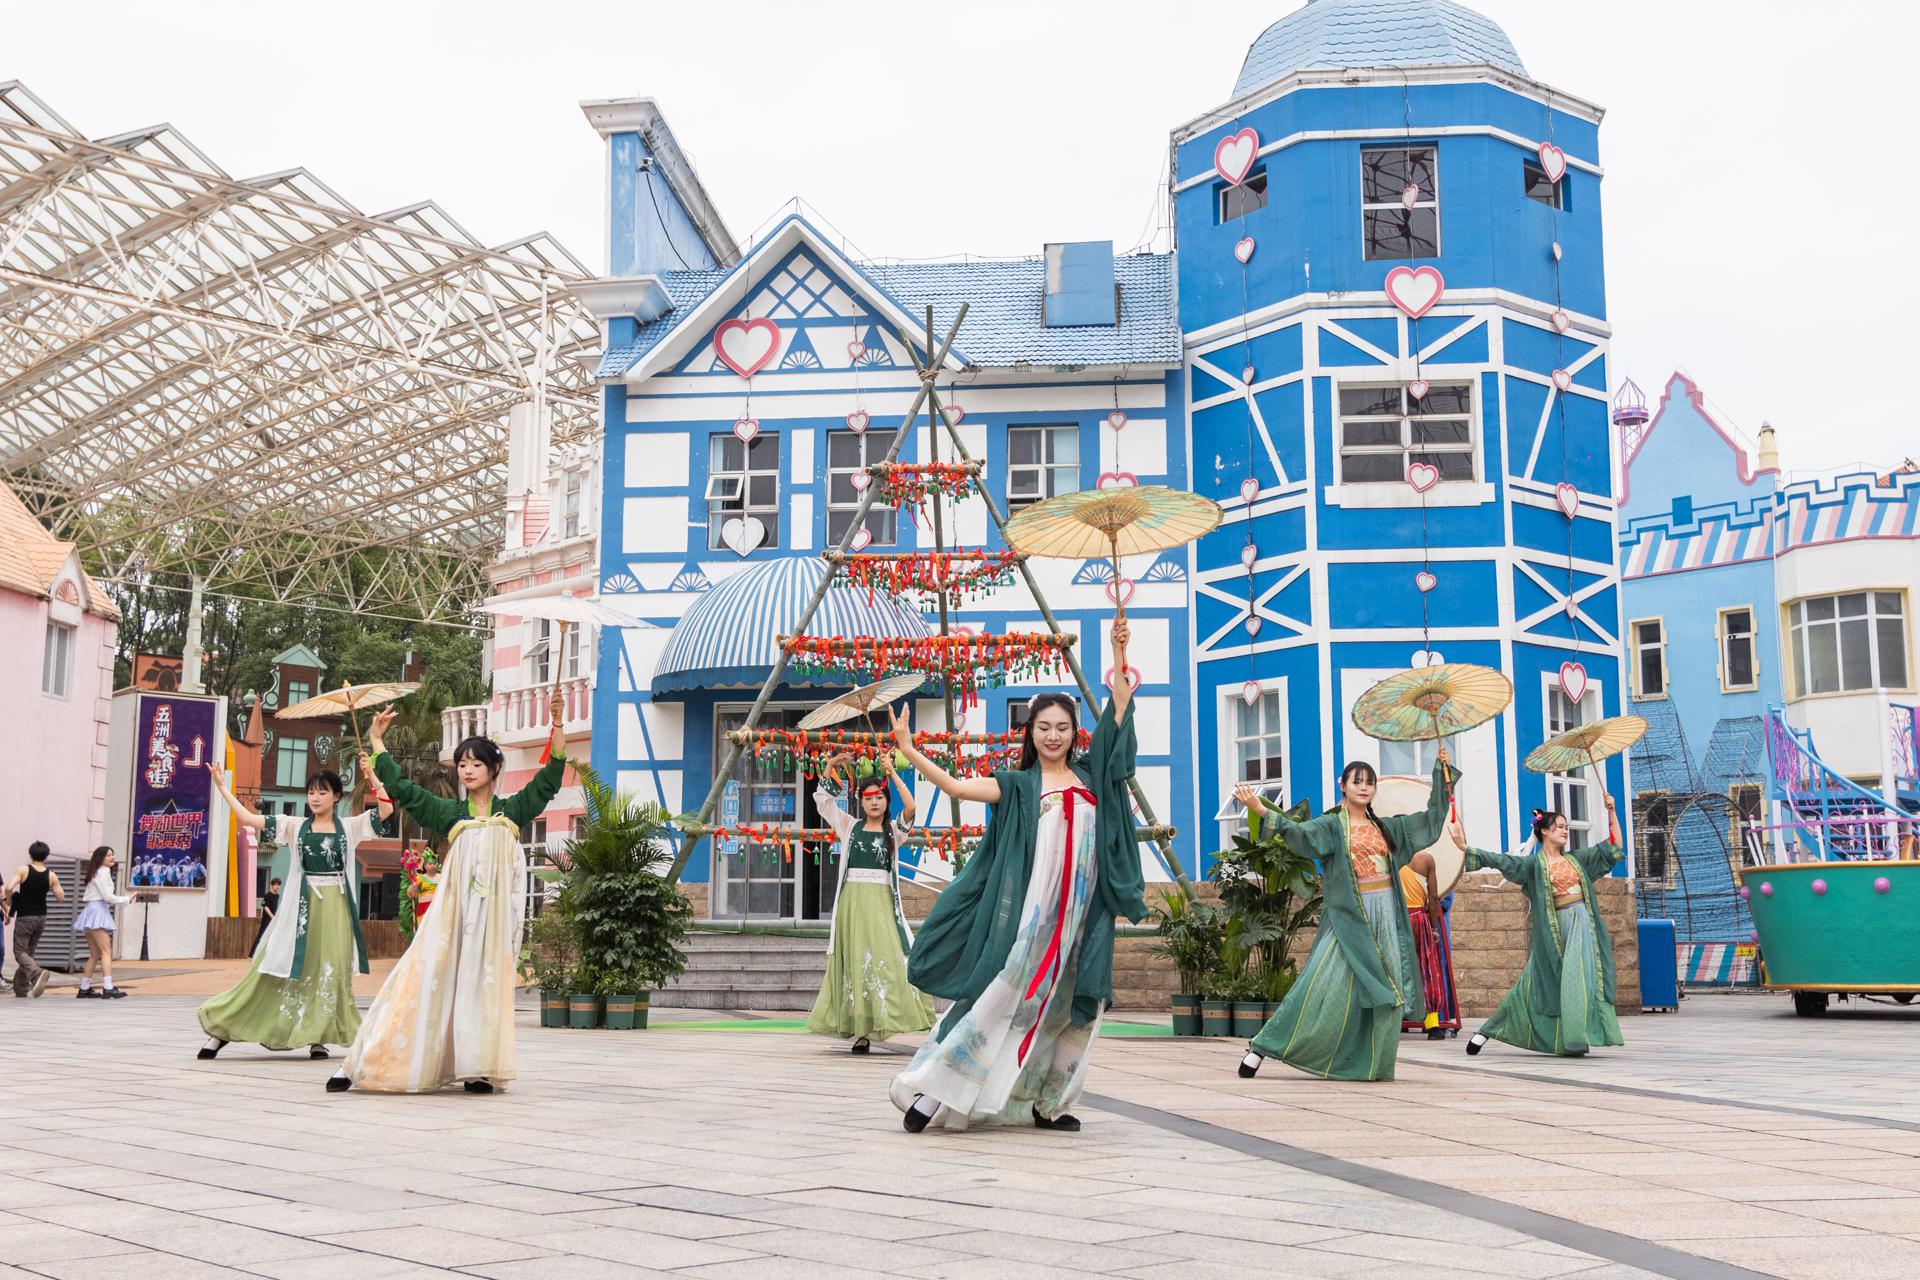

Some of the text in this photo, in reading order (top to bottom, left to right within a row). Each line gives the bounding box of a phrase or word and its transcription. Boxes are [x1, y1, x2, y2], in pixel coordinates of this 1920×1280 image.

[147, 705, 177, 785] 五洲美食街
[138, 811, 203, 838] 舞动世界
[146, 831, 193, 849] 歌舞秀
